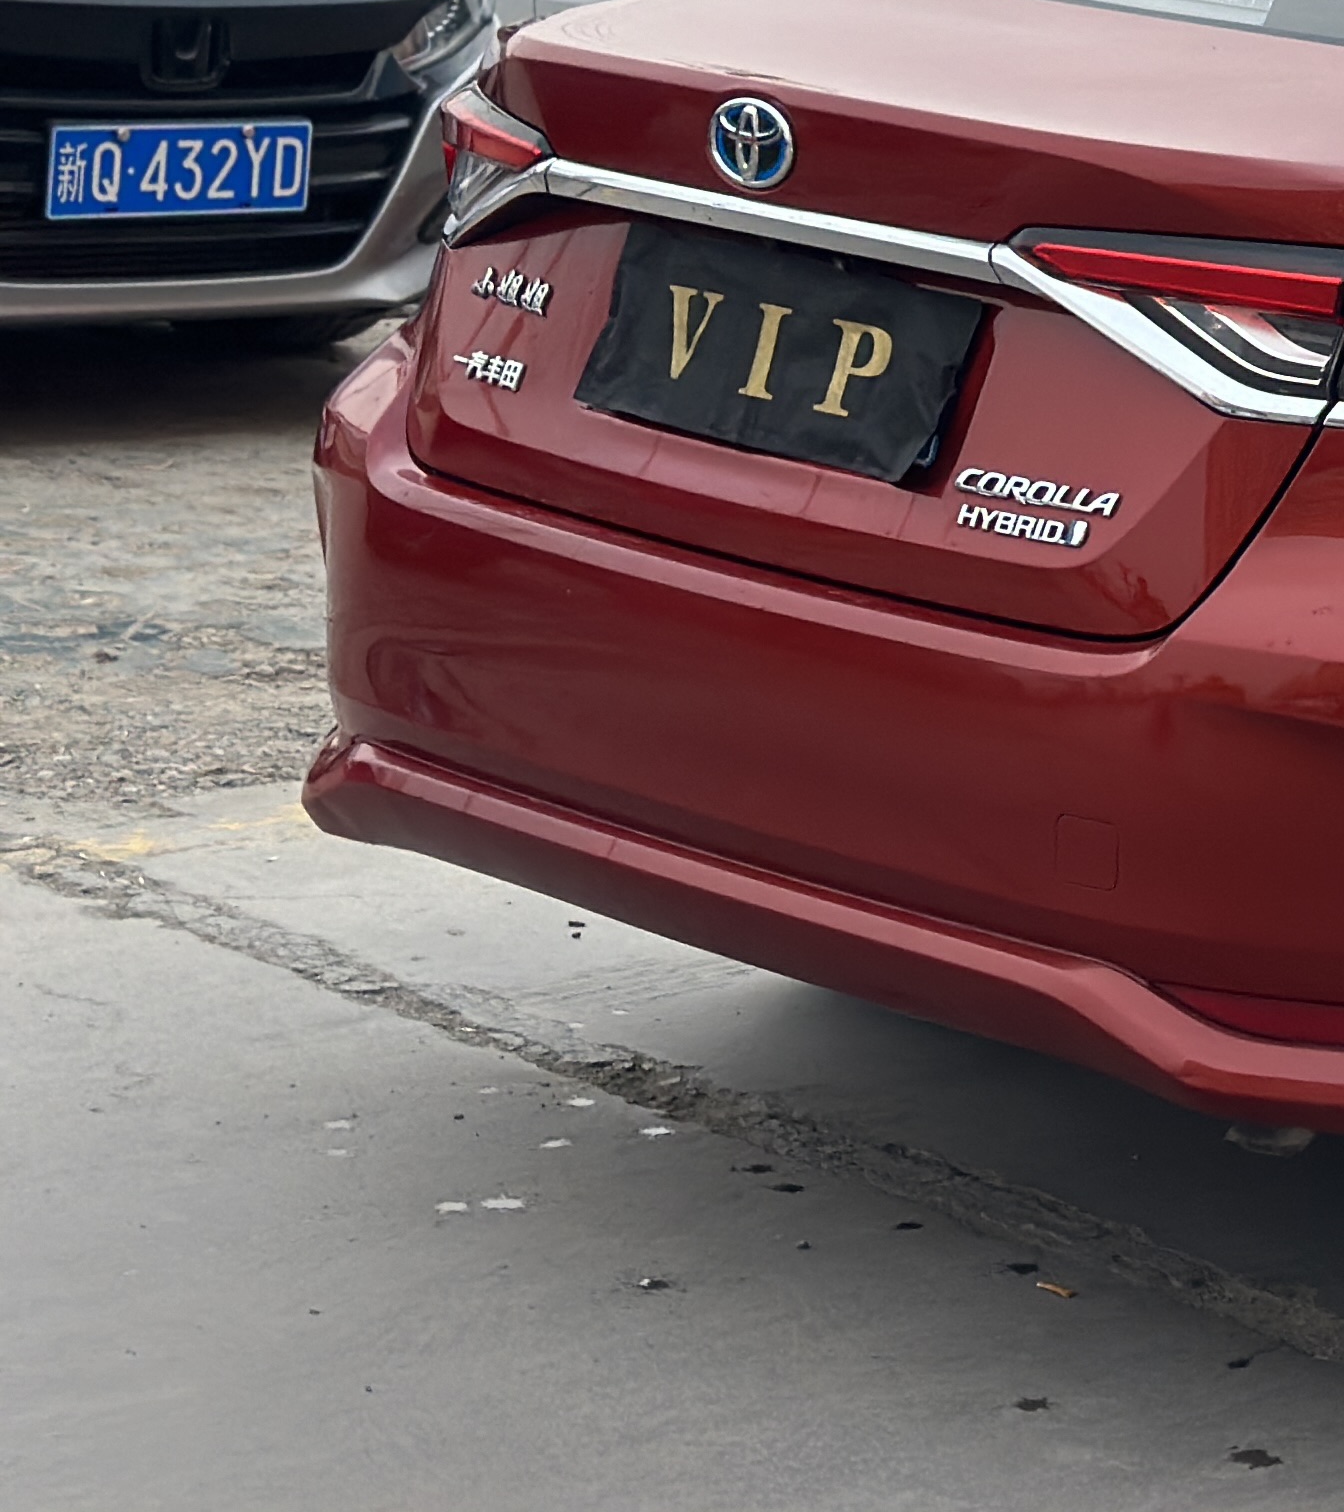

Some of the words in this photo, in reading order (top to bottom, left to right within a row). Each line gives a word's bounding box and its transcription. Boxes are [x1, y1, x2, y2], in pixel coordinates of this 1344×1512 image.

[453, 350, 525, 392] 一汽丰田
[669, 284, 893, 417] VIP
[955, 468, 1121, 517] COROLLA
[957, 504, 1066, 545] HYBRID
